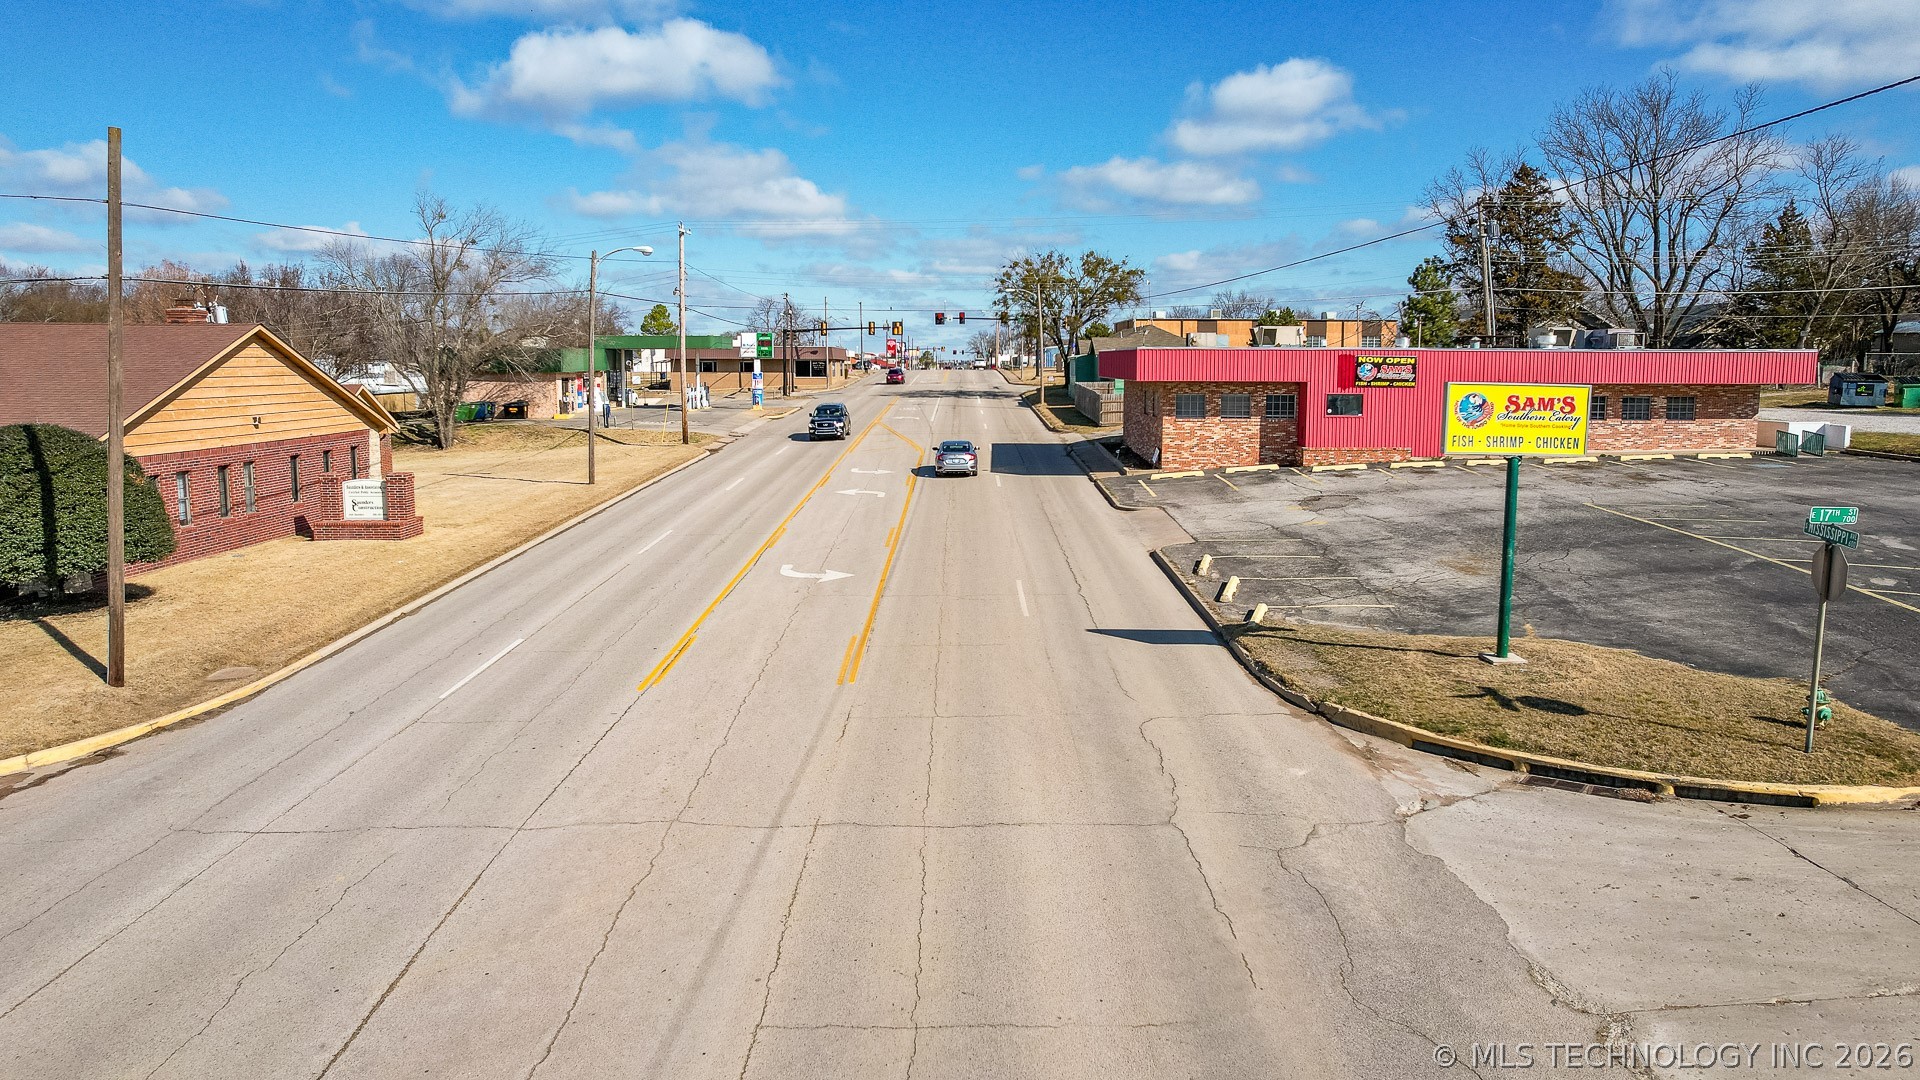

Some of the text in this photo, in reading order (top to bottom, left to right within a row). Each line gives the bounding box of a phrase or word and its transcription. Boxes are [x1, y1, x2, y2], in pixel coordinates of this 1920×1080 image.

[1380, 365, 1413, 373] SAM'S
[1505, 395, 1576, 414] SAM'S
[1497, 408, 1581, 430] Southern Eatery
[1452, 435, 1474, 447] FISH
[1486, 436, 1524, 448] SHRIMP
[1536, 436, 1579, 449] CHICKEN
[1820, 509, 1840, 521] 17TH
[1808, 524, 1849, 544] MISSISSIPPI
